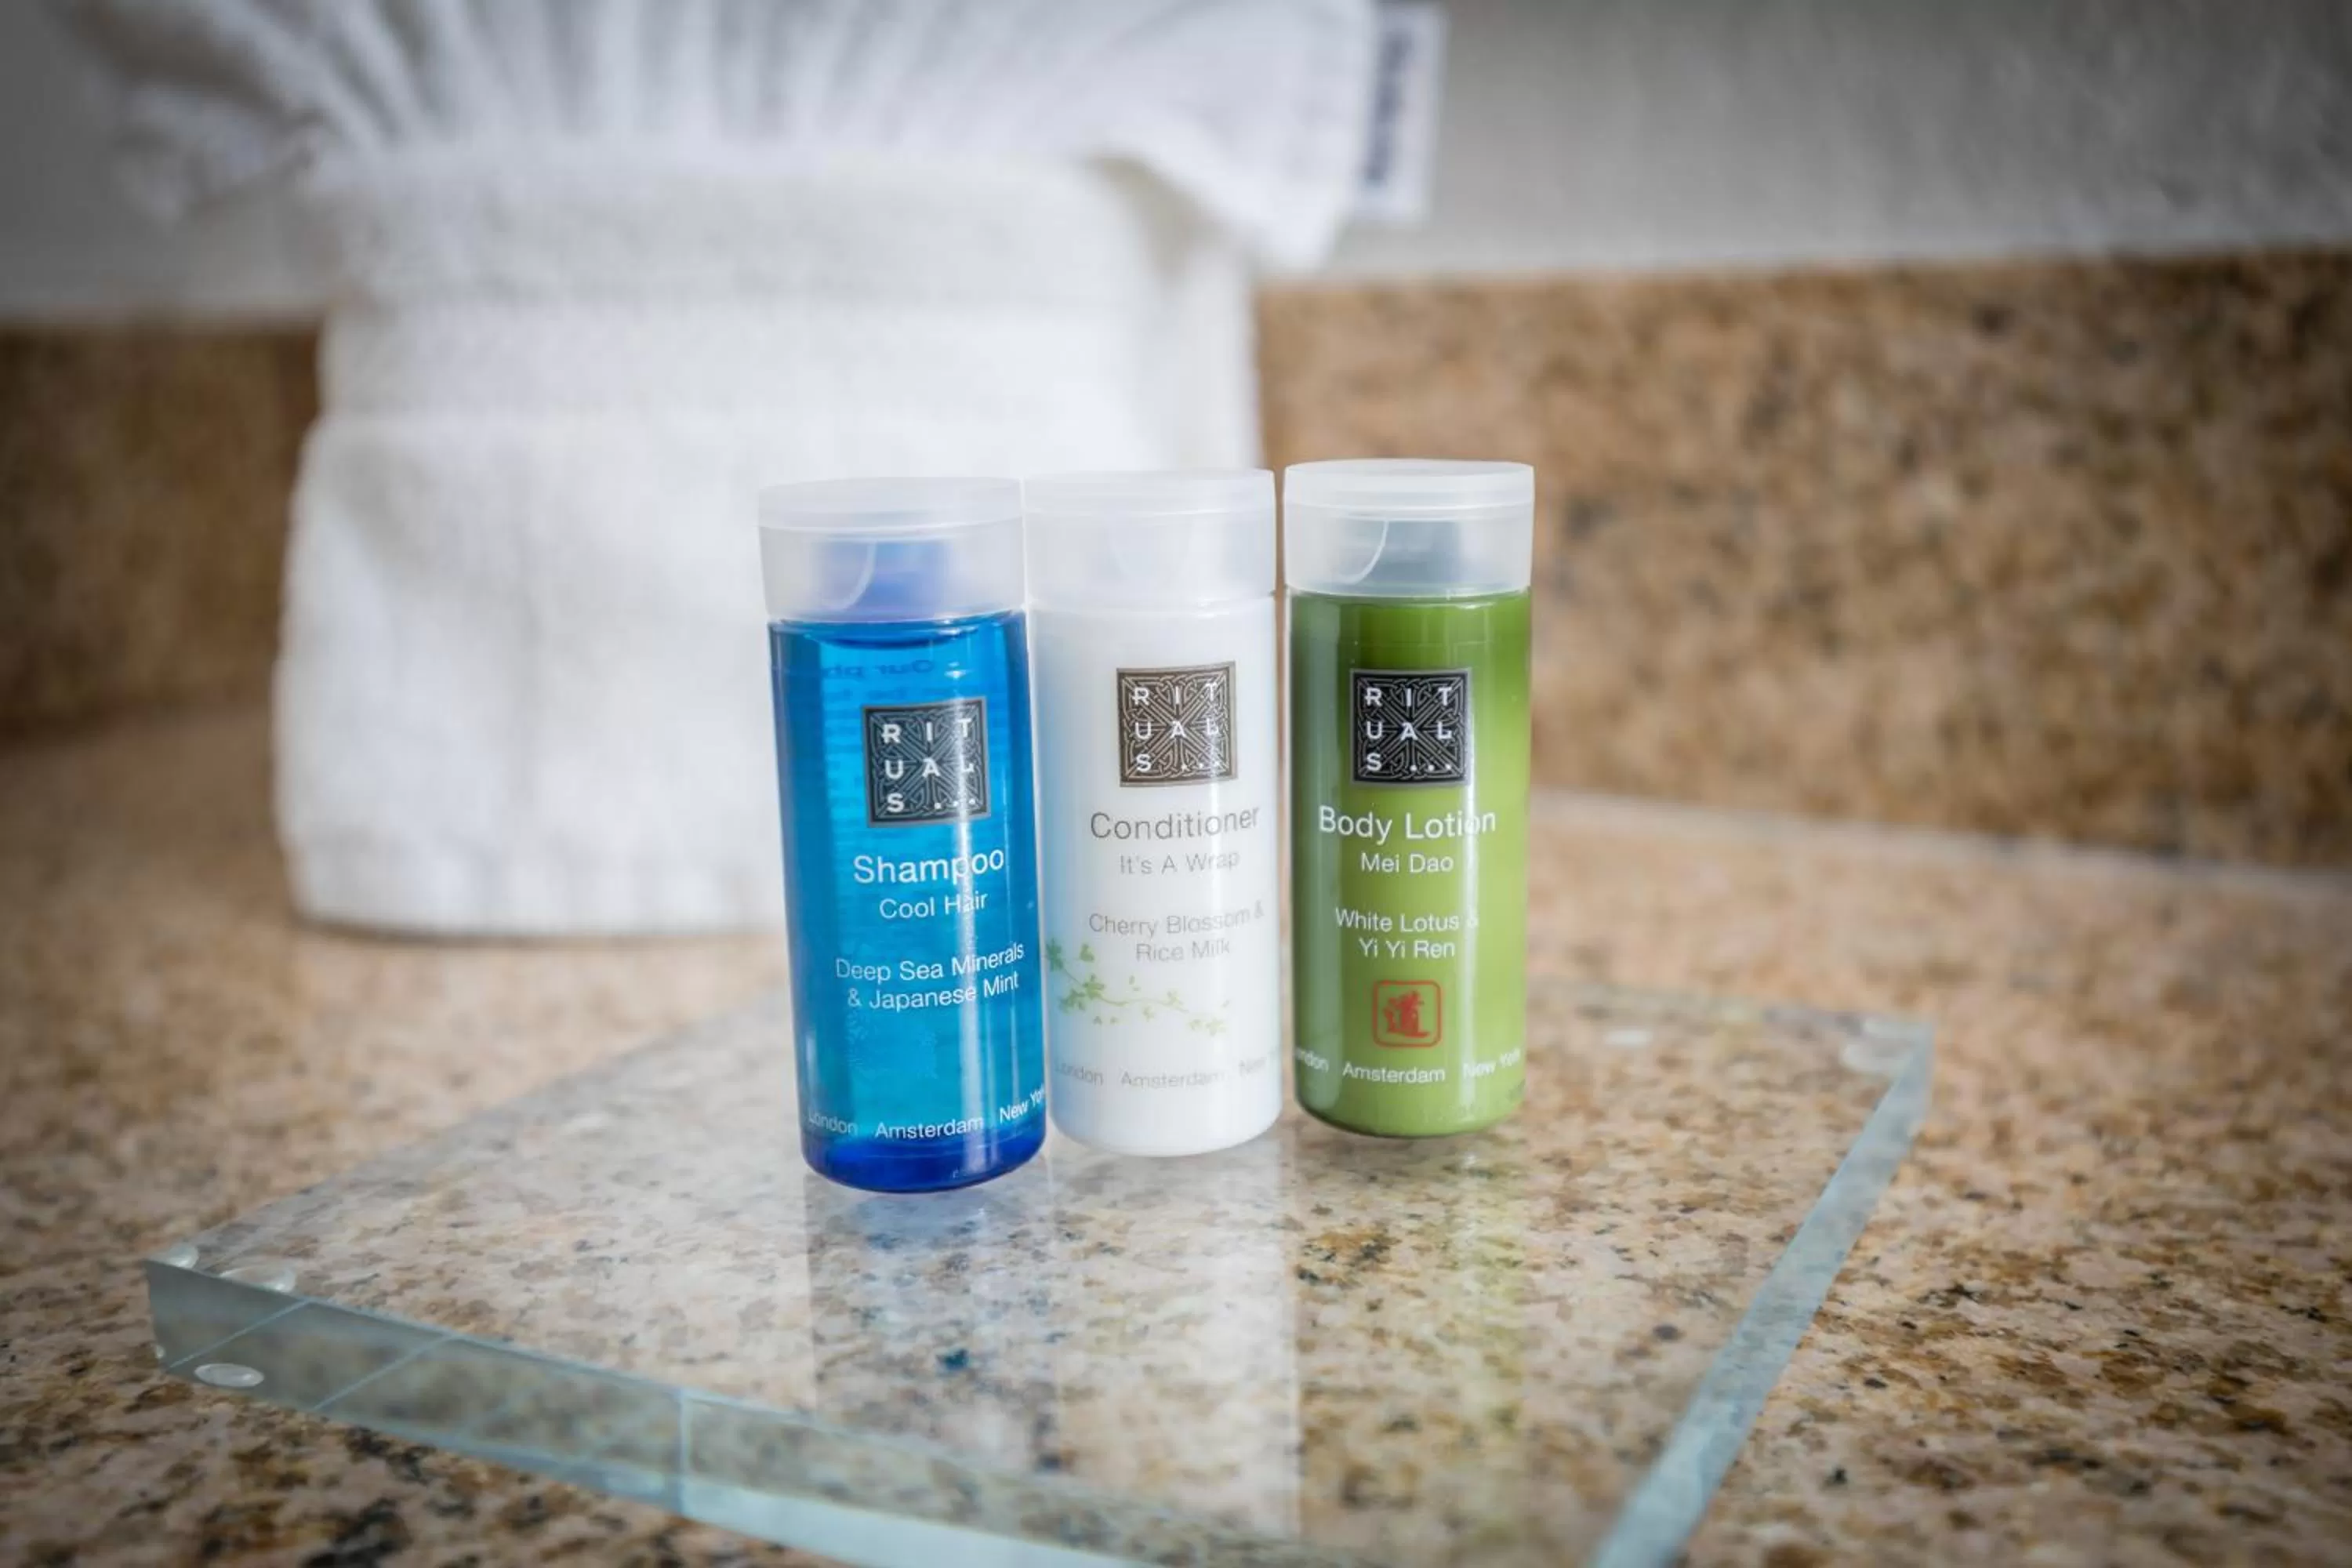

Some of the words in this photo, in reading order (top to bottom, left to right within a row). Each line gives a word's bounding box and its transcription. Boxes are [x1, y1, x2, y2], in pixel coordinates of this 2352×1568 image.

[1091, 806, 1259, 840] Conditioner
[1319, 805, 1392, 846] Body
[1405, 811, 1496, 840] Lotion
[853, 849, 1004, 885] Shampoo
[1120, 853, 1152, 875] It's
[1161, 855, 1178, 874] A
[1185, 851, 1240, 873] Wrap
[1361, 852, 1400, 873] Mei
[1410, 854, 1454, 873] Dao
[880, 898, 935, 919] Cool
[945, 890, 988, 914] Hair
[1088, 913, 1158, 938] Cherry
[1166, 907, 1250, 935] Blossom
[1335, 907, 1393, 932] White
[1400, 913, 1460, 933] Lotus
[1135, 942, 1185, 962] Rice
[1191, 938, 1231, 959] Milk
[1359, 938, 1378, 957] Yi
[1385, 940, 1406, 959] Yi
[1414, 939, 1455, 959] Ren
[835, 957, 891, 985] Deep
[899, 960, 943, 981] Sea
[951, 942, 1024, 975] Minerals
[847, 987, 861, 1007] &
[869, 985, 976, 1012] Japanese
[983, 971, 1019, 998] Mint
[1120, 1067, 1224, 1088] Amsterdam
[1342, 1062, 1446, 1083] Amsterdam
[808, 1111, 858, 1135] London
[874, 1115, 985, 1140] Amsterdam
[999, 1098, 1029, 1123] New
